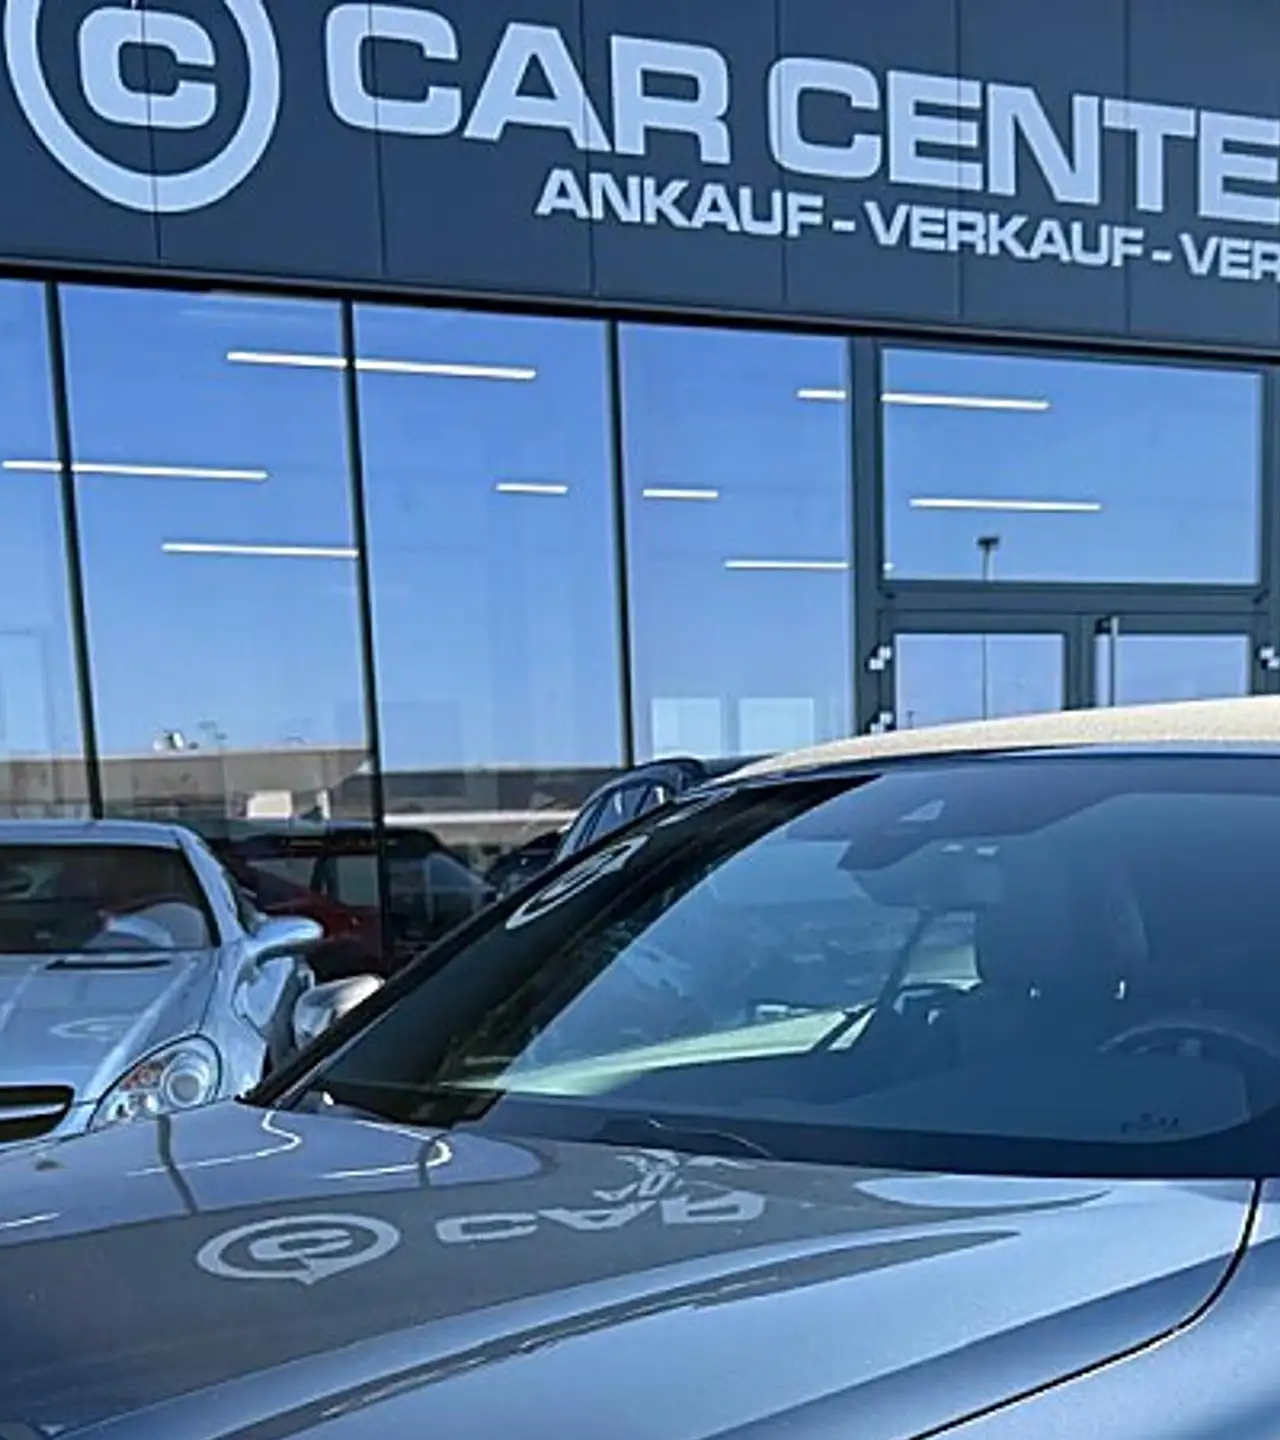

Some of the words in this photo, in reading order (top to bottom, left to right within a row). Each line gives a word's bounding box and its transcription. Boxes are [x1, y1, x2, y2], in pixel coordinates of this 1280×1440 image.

[325, 3, 732, 165] CAR
[535, 168, 825, 238] ANKAUF
[863, 200, 1146, 268] VERKAUF
